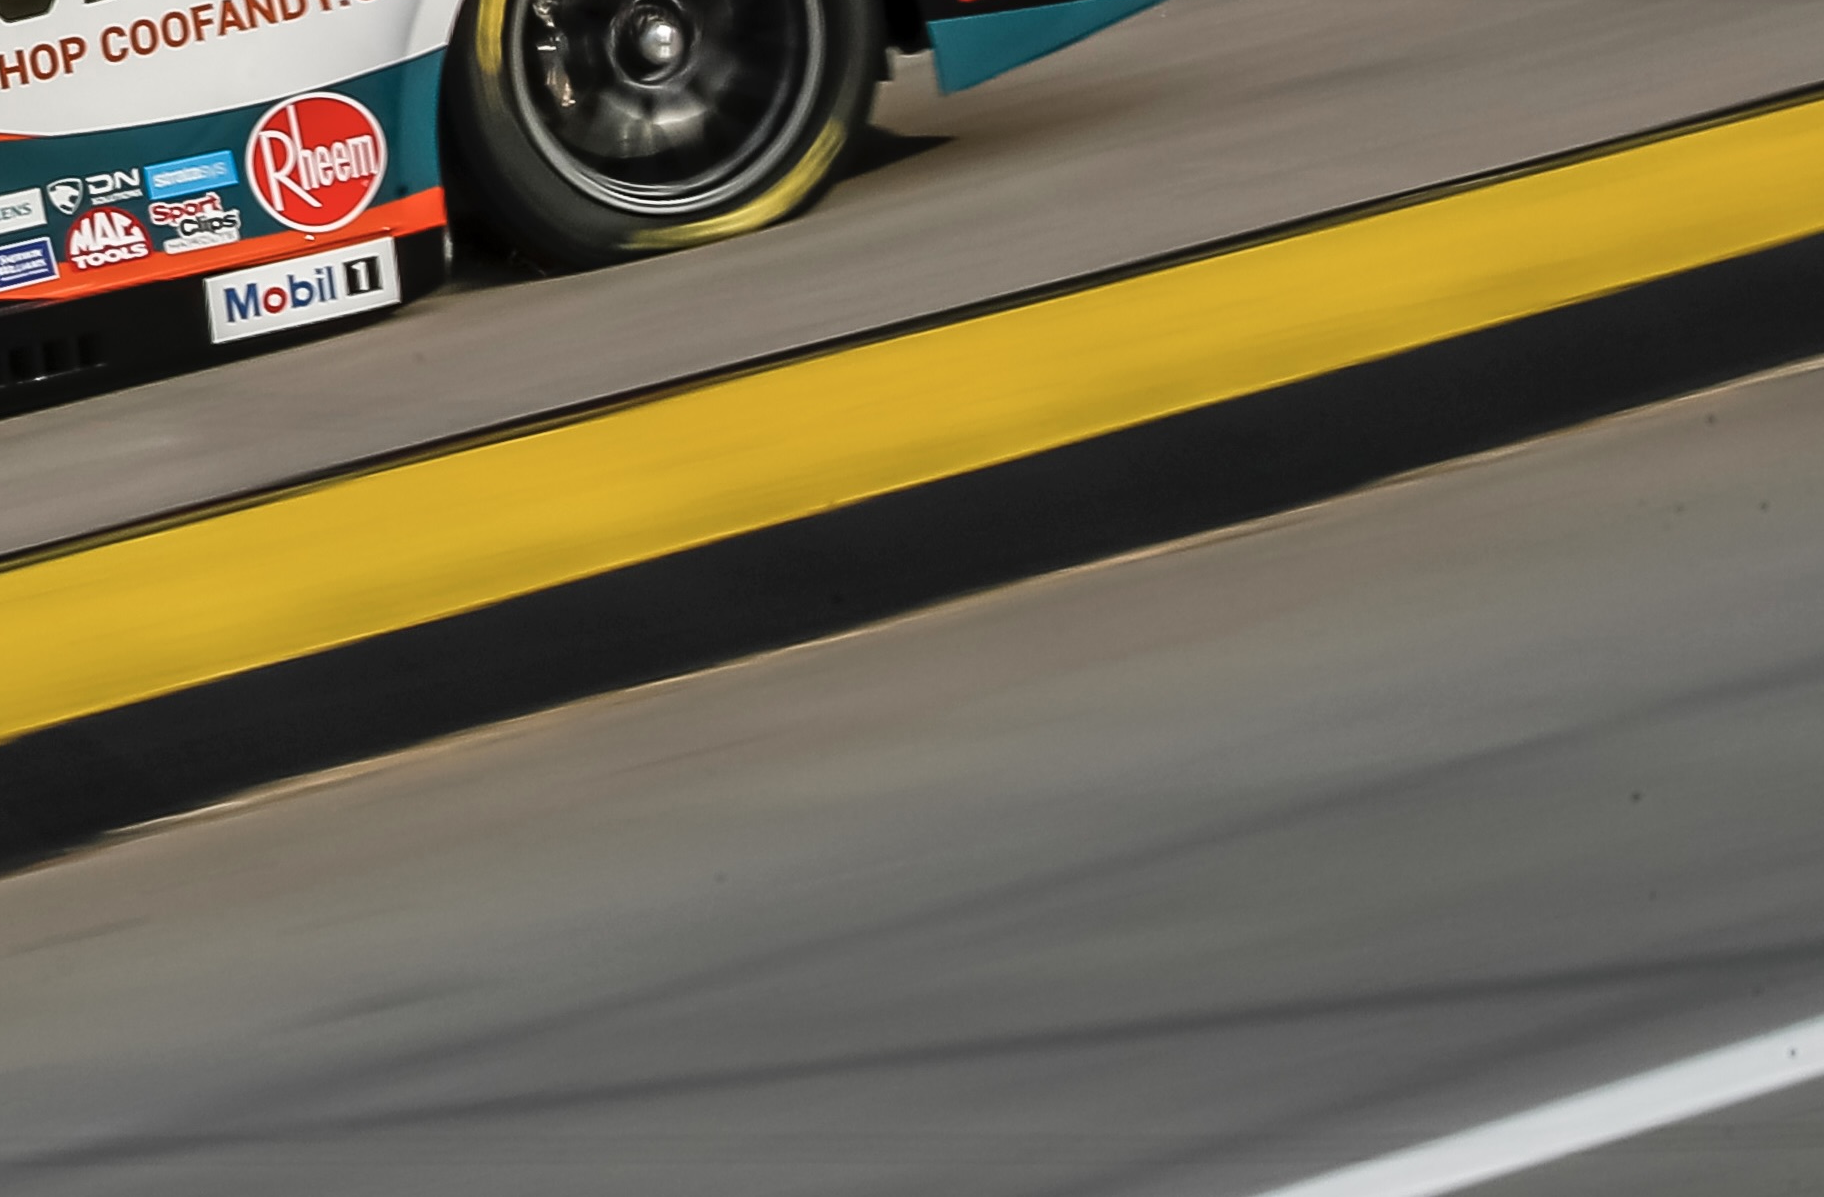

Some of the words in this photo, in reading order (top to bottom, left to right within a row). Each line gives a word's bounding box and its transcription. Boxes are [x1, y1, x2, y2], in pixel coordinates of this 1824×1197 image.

[258, 104, 379, 212] Rheem
[84, 168, 141, 195] DN
[153, 195, 219, 224] Sport
[69, 211, 148, 255] MAC
[180, 214, 238, 237] Clips
[71, 243, 150, 269] TOOLS
[223, 265, 338, 323] Mobil
